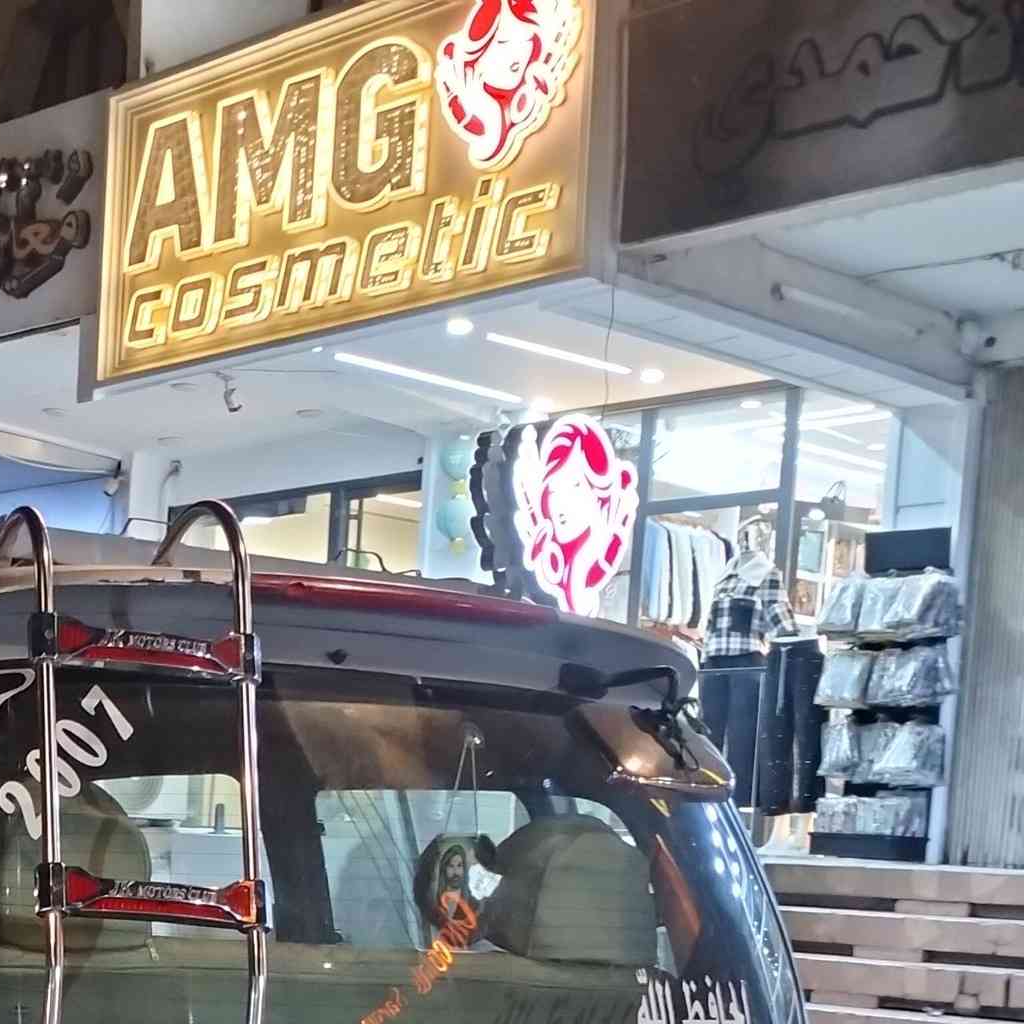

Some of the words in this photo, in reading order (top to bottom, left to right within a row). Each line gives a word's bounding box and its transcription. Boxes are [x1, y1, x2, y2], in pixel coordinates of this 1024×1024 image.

[124, 36, 431, 273] AMG
[126, 175, 559, 349] cosmetic
[127, 634, 176, 651] MOTORS
[136, 884, 186, 901] MOTORS
